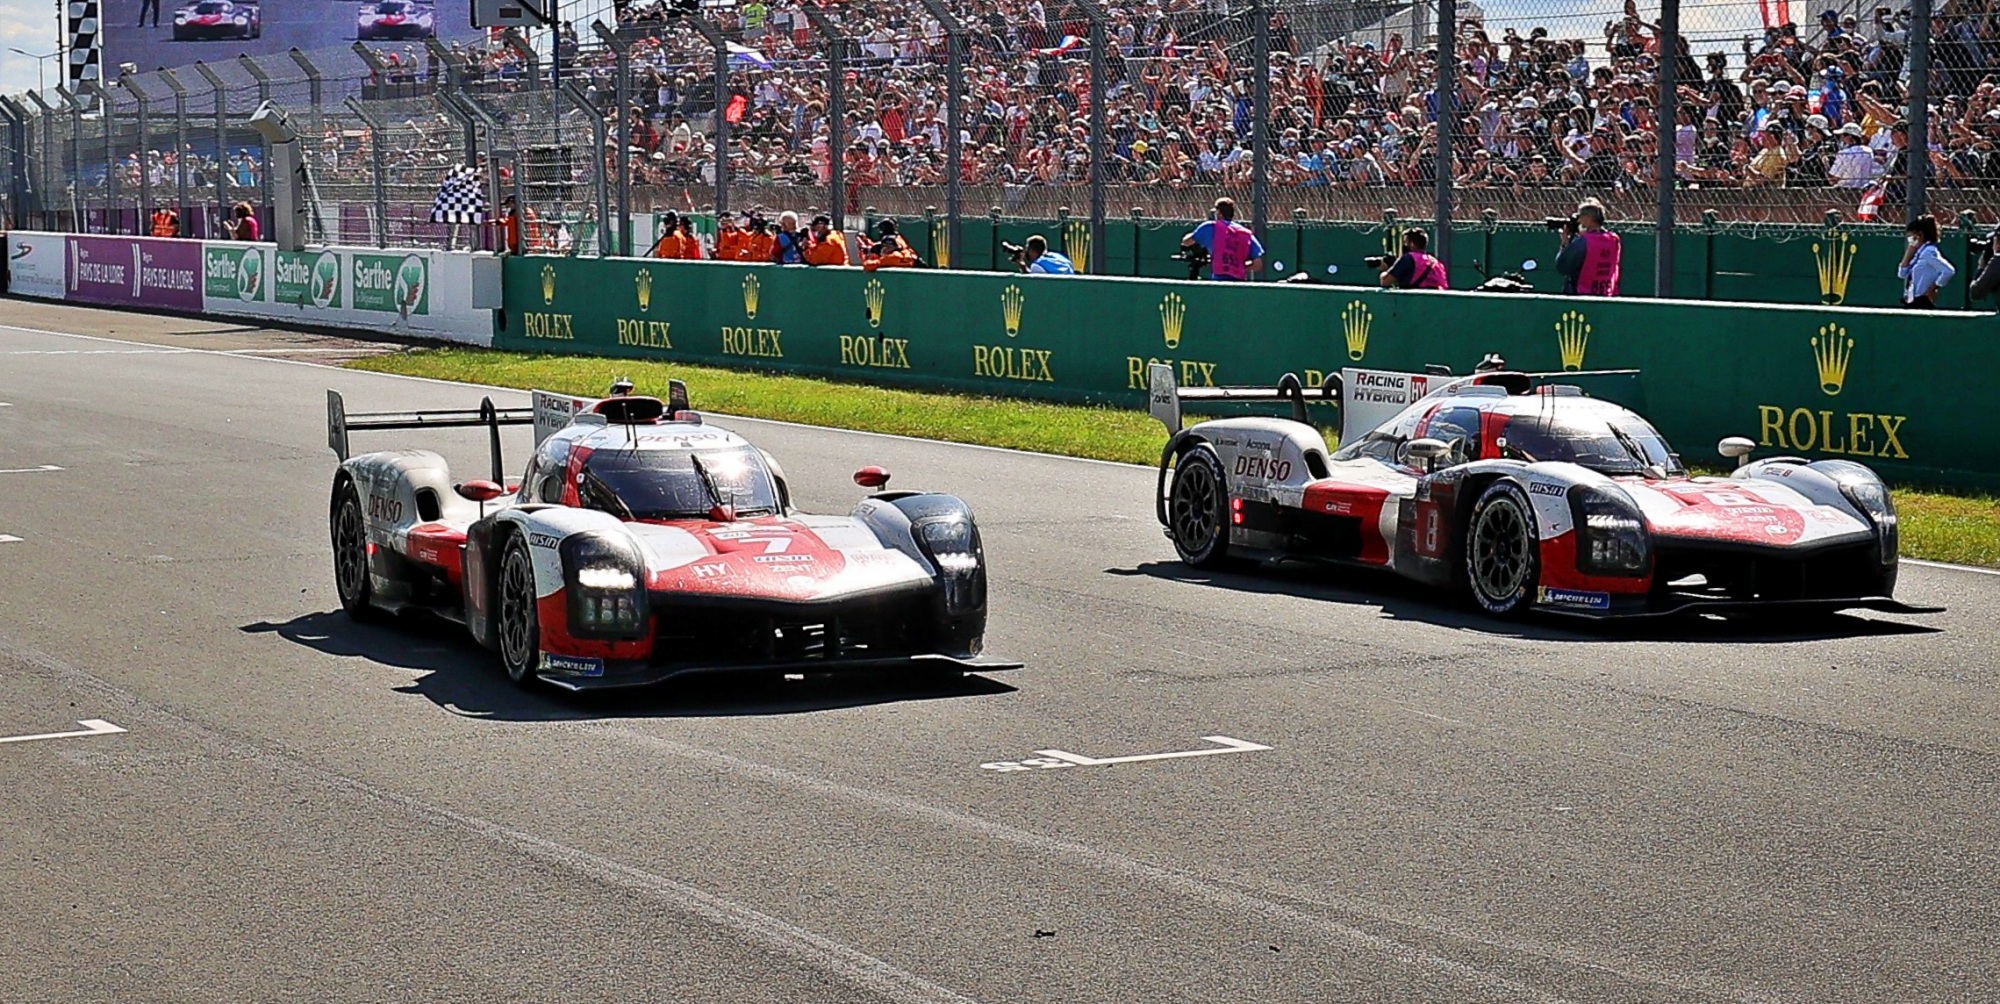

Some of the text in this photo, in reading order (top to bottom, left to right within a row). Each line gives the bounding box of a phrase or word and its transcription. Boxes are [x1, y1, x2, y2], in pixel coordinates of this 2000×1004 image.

[143, 267, 158, 287] PAYS
[159, 268, 167, 288] DE
[167, 269, 176, 289] LA
[176, 270, 194, 291] LOIRE
[207, 253, 236, 279] Sarthe
[277, 255, 309, 284] Sarthe
[355, 260, 392, 290] Sarthe
[524, 312, 574, 339] ROLEX
[617, 318, 673, 349] ROLEX
[721, 326, 783, 358] ROLEX
[839, 334, 911, 369] ROLEX
[973, 344, 1054, 382] ROLEX
[1356, 372, 1405, 389] RACING
[1411, 381, 1427, 402] HY
[541, 394, 570, 413] RACING
[1354, 388, 1407, 404] HYBRID
[638, 433, 718, 443] DENSO
[1757, 404, 1909, 459] ROLEX
[1235, 455, 1291, 481] DENSO
[368, 494, 402, 524] DENSO
[738, 537, 793, 553] 7
[694, 563, 727, 578] HY
[1554, 593, 1602, 604] MICHELIN
[552, 659, 596, 671] MICHELIN
